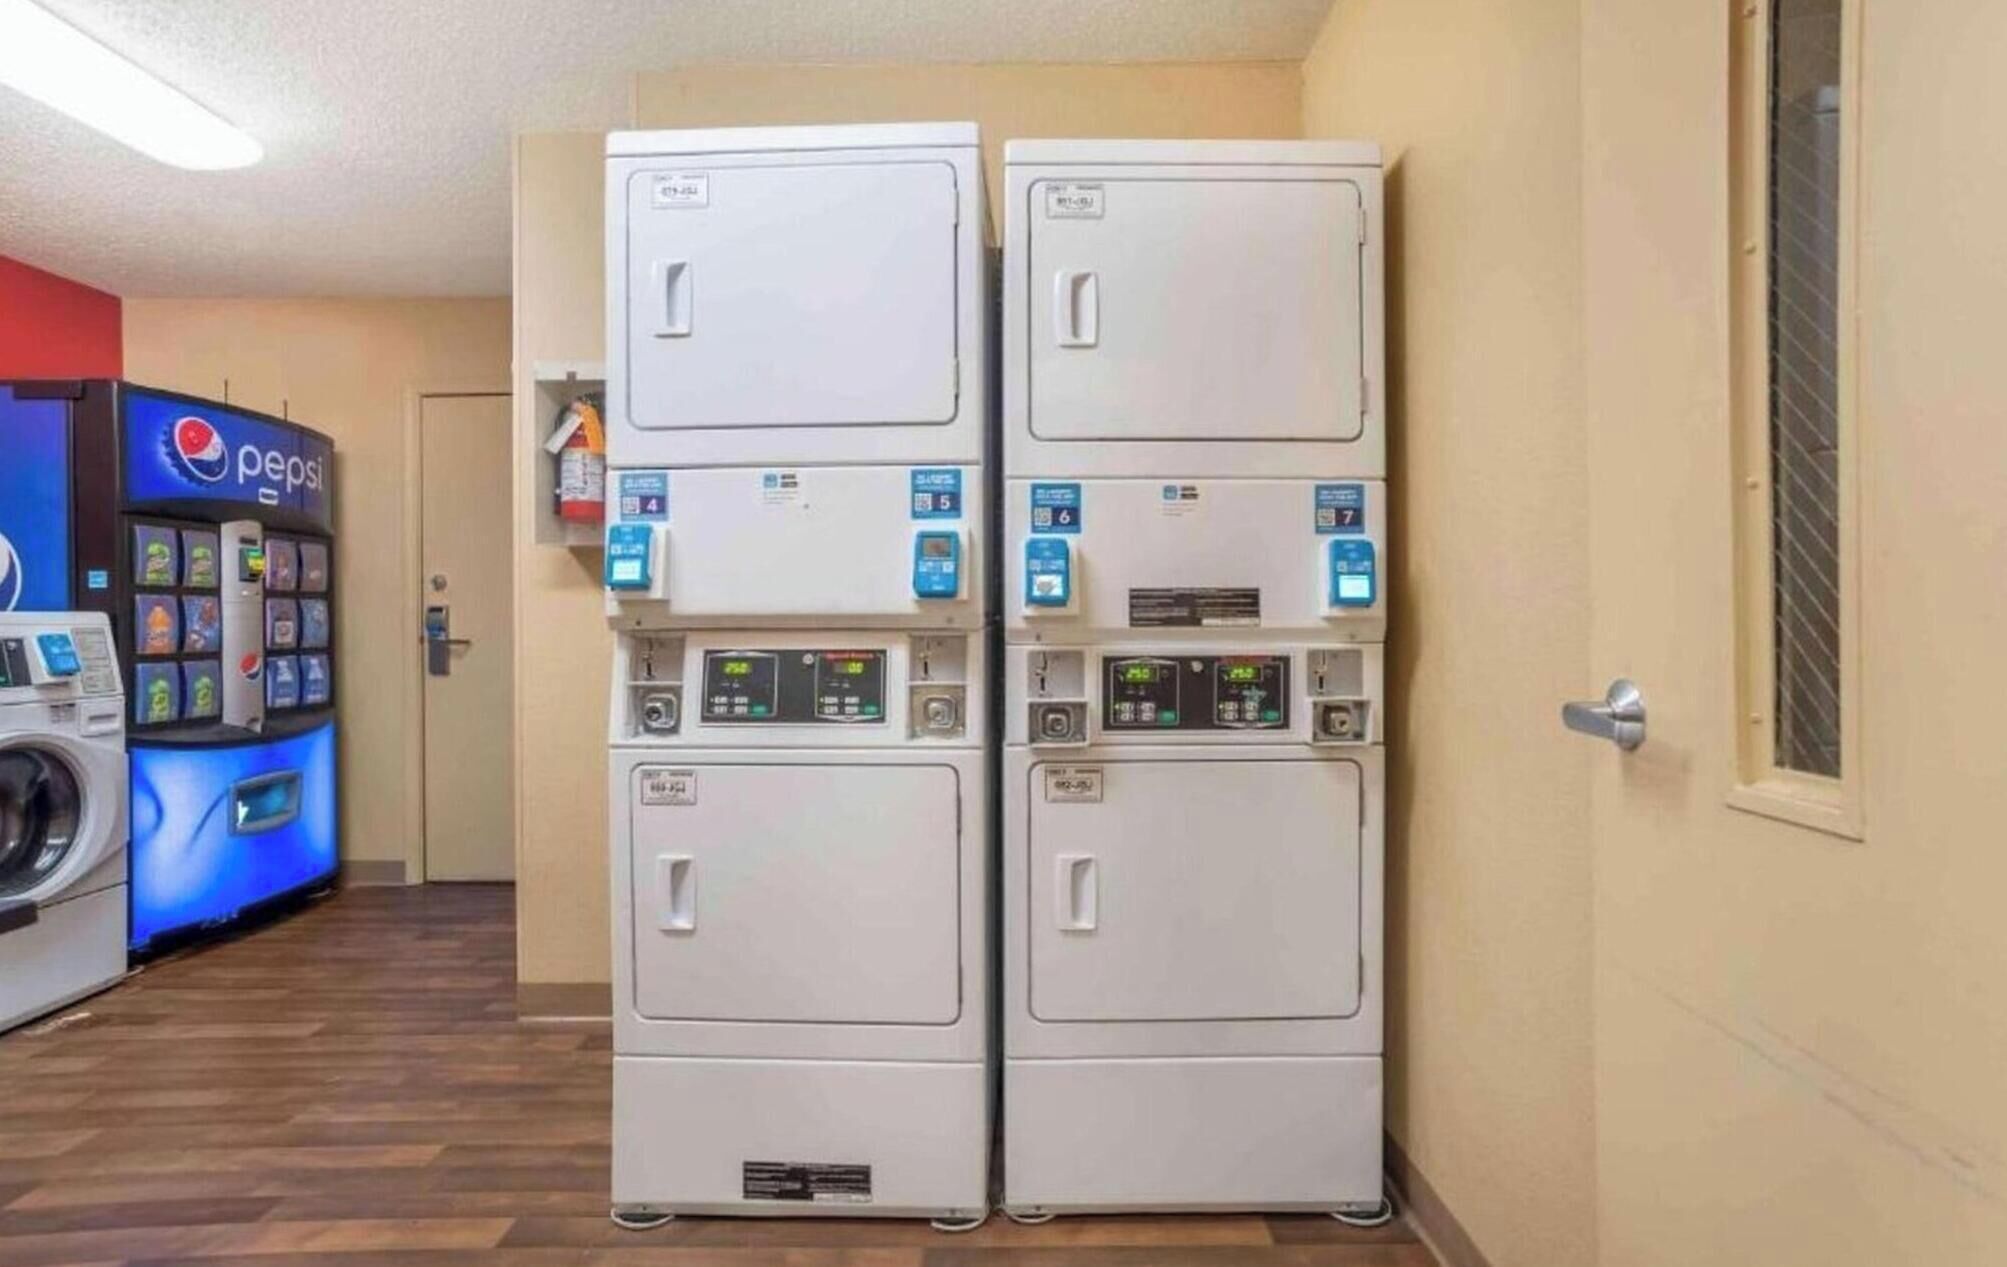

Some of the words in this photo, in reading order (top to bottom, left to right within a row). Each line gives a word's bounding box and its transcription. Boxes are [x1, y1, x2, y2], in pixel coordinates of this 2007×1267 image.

[238, 445, 323, 494] pepsi
[647, 498, 658, 511] 4
[940, 495, 950, 510] 5
[1059, 509, 1070, 524] 6
[1342, 510, 1353, 525] 7
